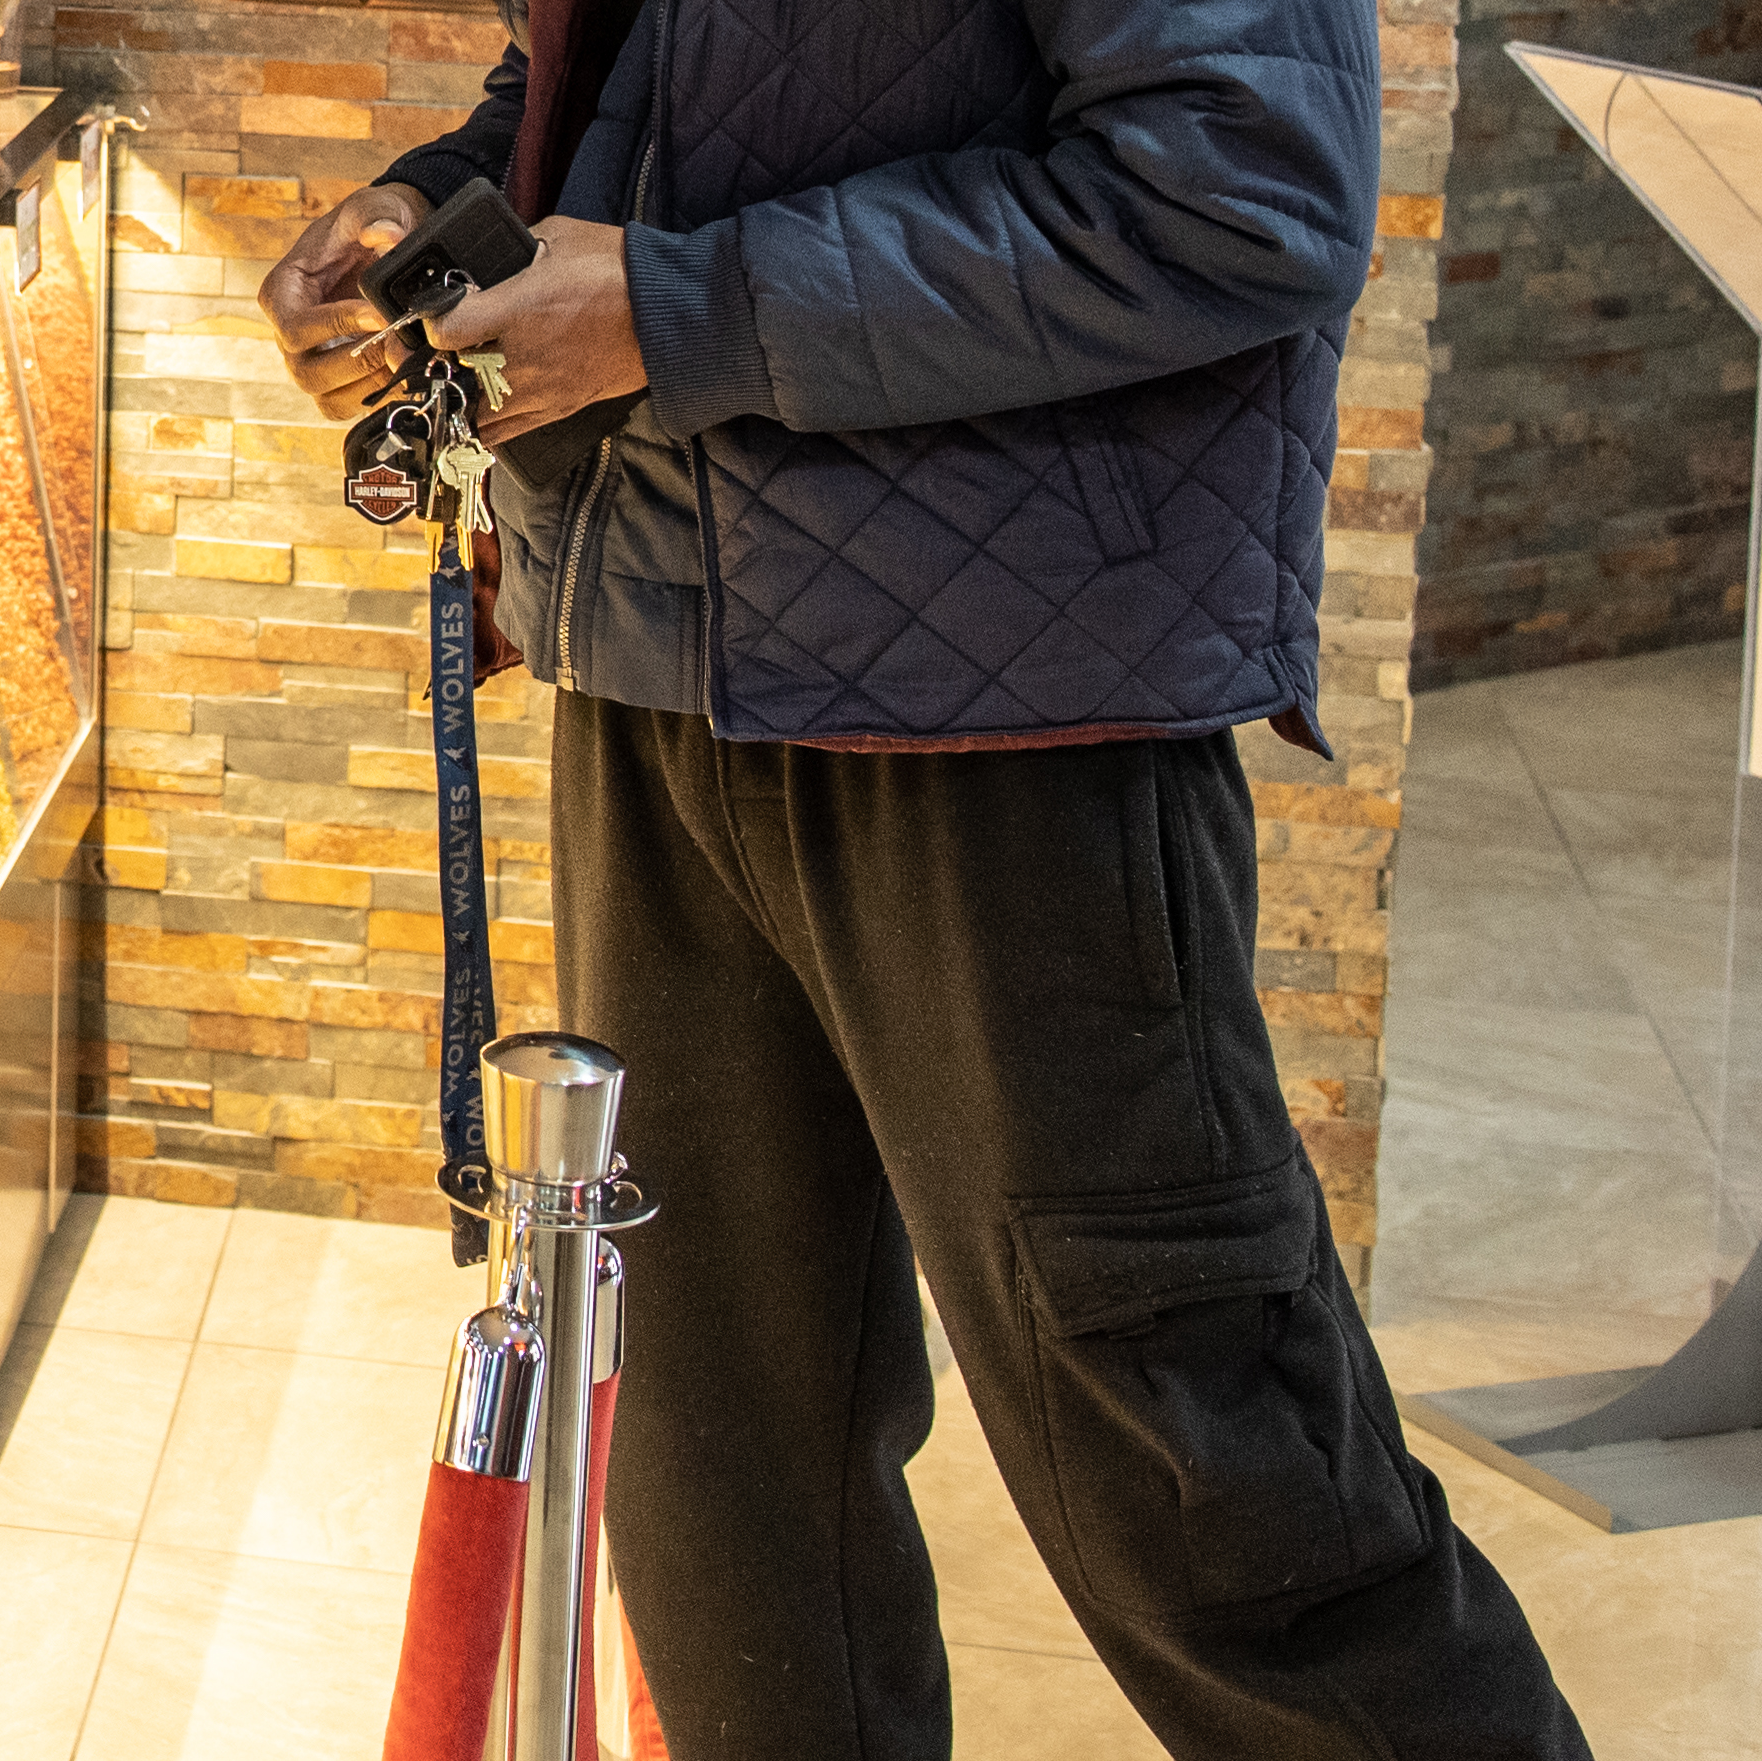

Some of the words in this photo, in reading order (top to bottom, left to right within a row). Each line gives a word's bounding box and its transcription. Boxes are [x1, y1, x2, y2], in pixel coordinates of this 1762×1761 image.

[441, 602, 464, 734] WOLVES
[448, 784, 472, 918] WOLVES
[444, 967, 470, 1098] WOLVES
